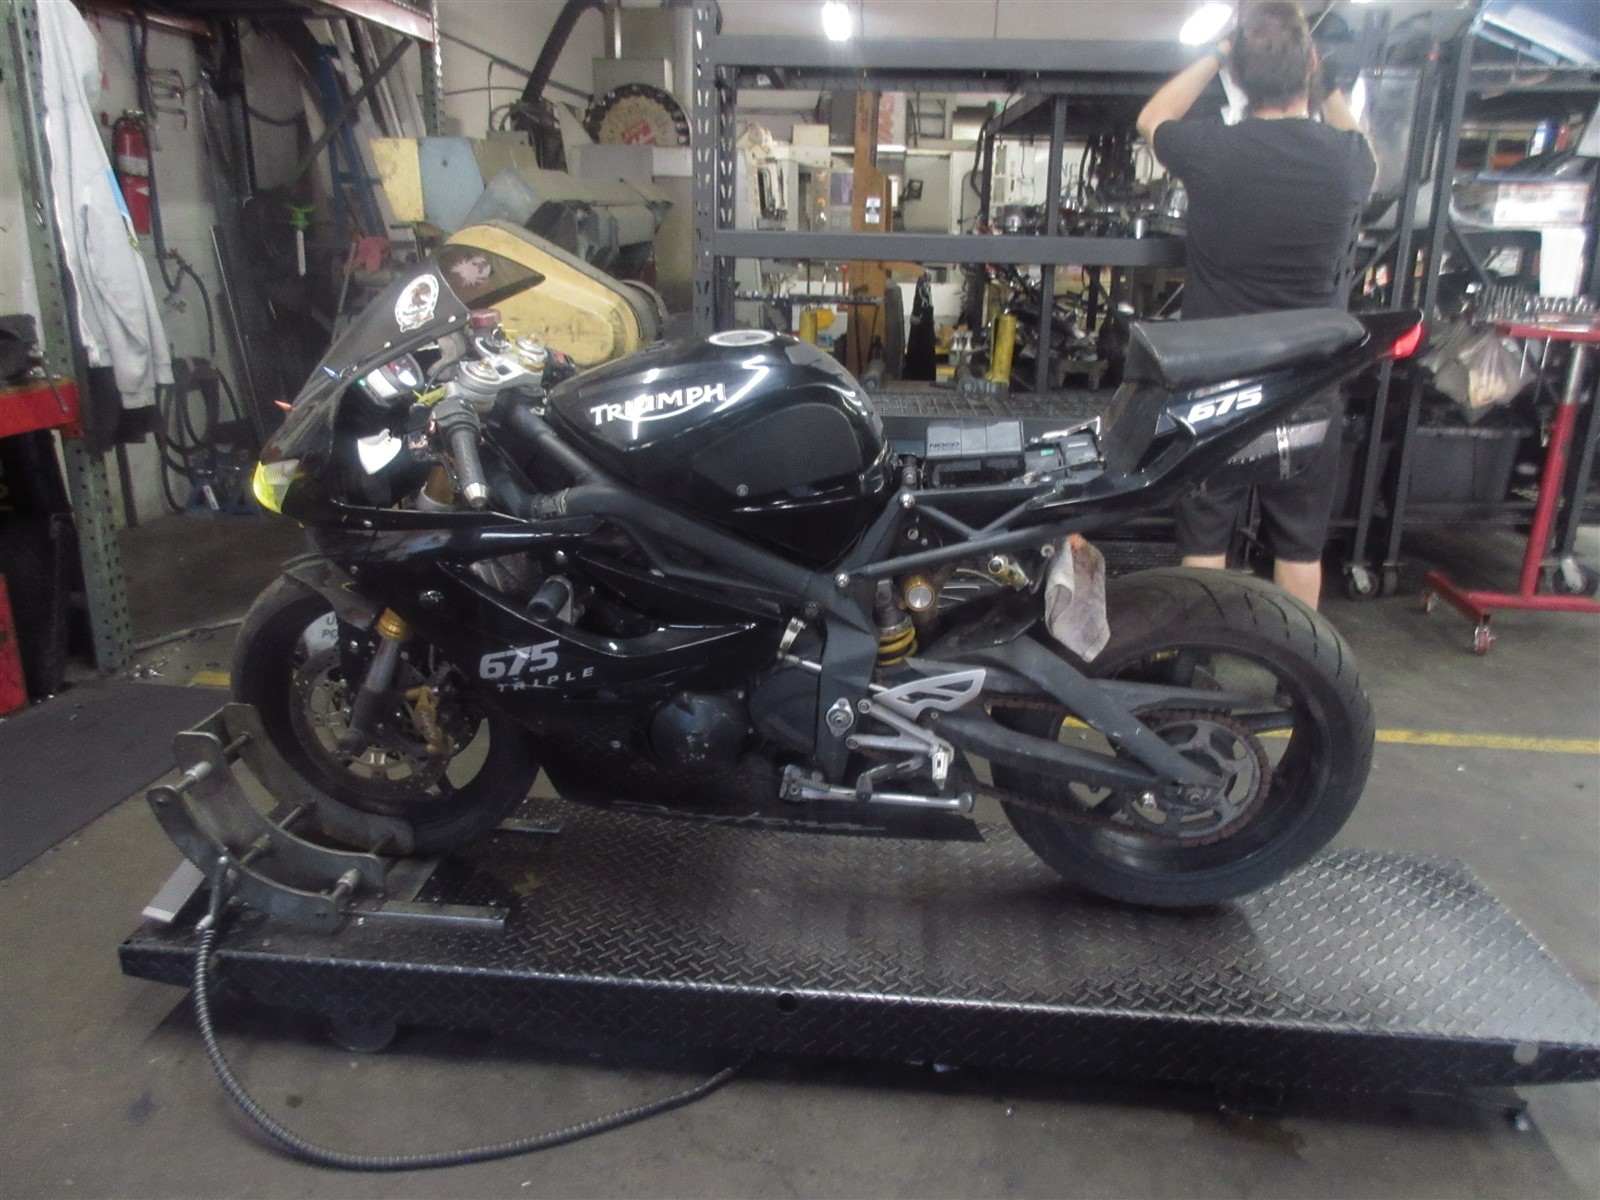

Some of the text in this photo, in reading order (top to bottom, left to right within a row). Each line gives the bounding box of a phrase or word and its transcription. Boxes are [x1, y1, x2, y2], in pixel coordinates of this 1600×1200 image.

[590, 383, 726, 426] TRIUMPH
[1187, 385, 1263, 424] 675
[479, 639, 559, 679] 675
[497, 666, 594, 692] TRIPLE
